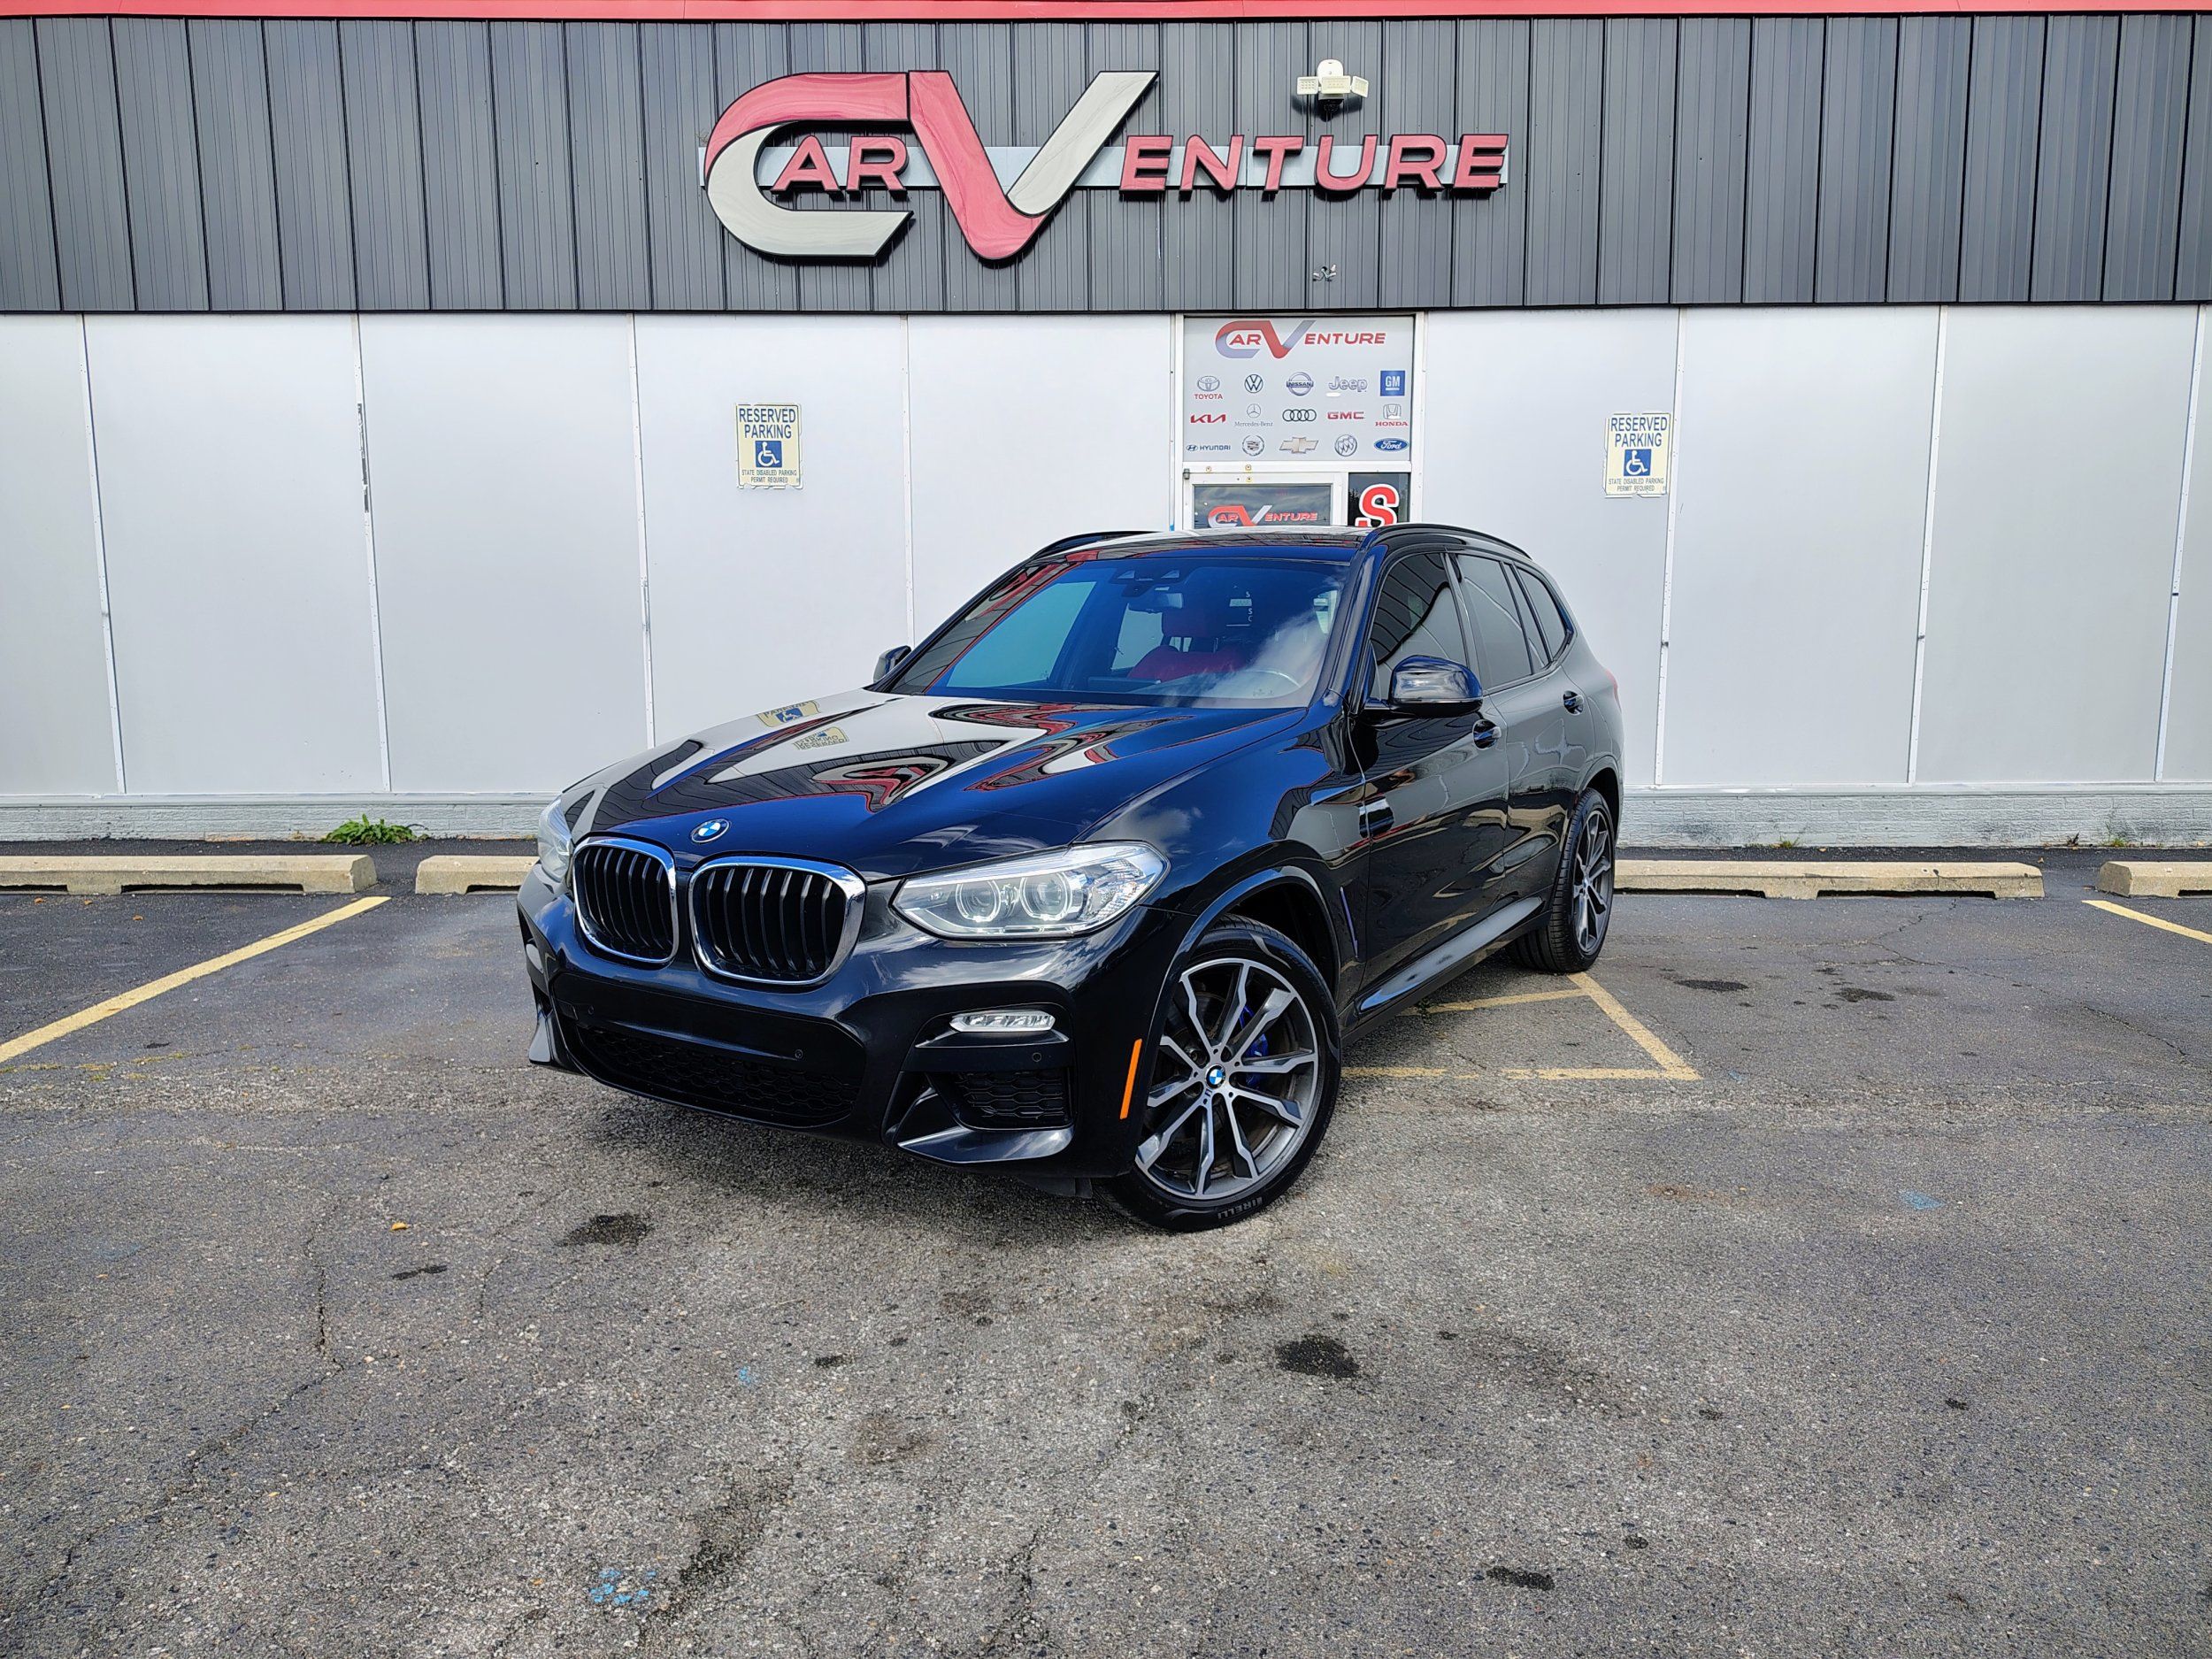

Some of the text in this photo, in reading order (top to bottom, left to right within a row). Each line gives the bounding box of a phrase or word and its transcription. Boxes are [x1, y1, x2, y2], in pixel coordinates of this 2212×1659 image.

[1328, 376, 1368, 392] Jeep
[1385, 375, 1401, 388] GM
[739, 408, 796, 423] RESERVED
[1611, 417, 1668, 432] RESERVED
[744, 425, 792, 439] PARKING
[1381, 440, 1402, 449] Ford
[1615, 433, 1662, 447] PARKING
